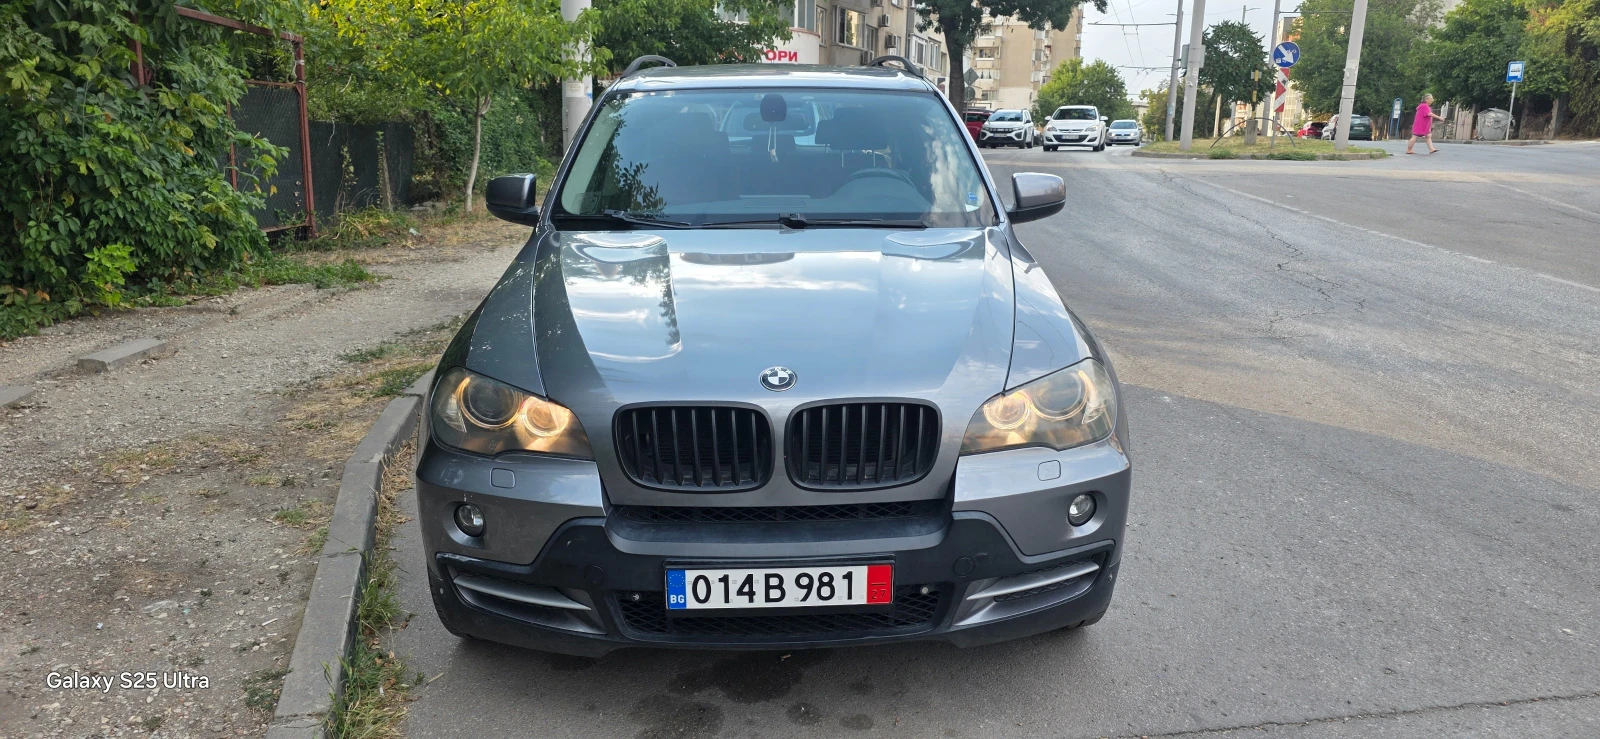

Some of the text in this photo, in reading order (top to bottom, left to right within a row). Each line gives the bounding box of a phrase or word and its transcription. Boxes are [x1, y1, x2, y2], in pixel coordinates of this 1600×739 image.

[757, 49, 798, 62] ОРИ
[669, 594, 685, 604] BG
[871, 589, 886, 600] 27
